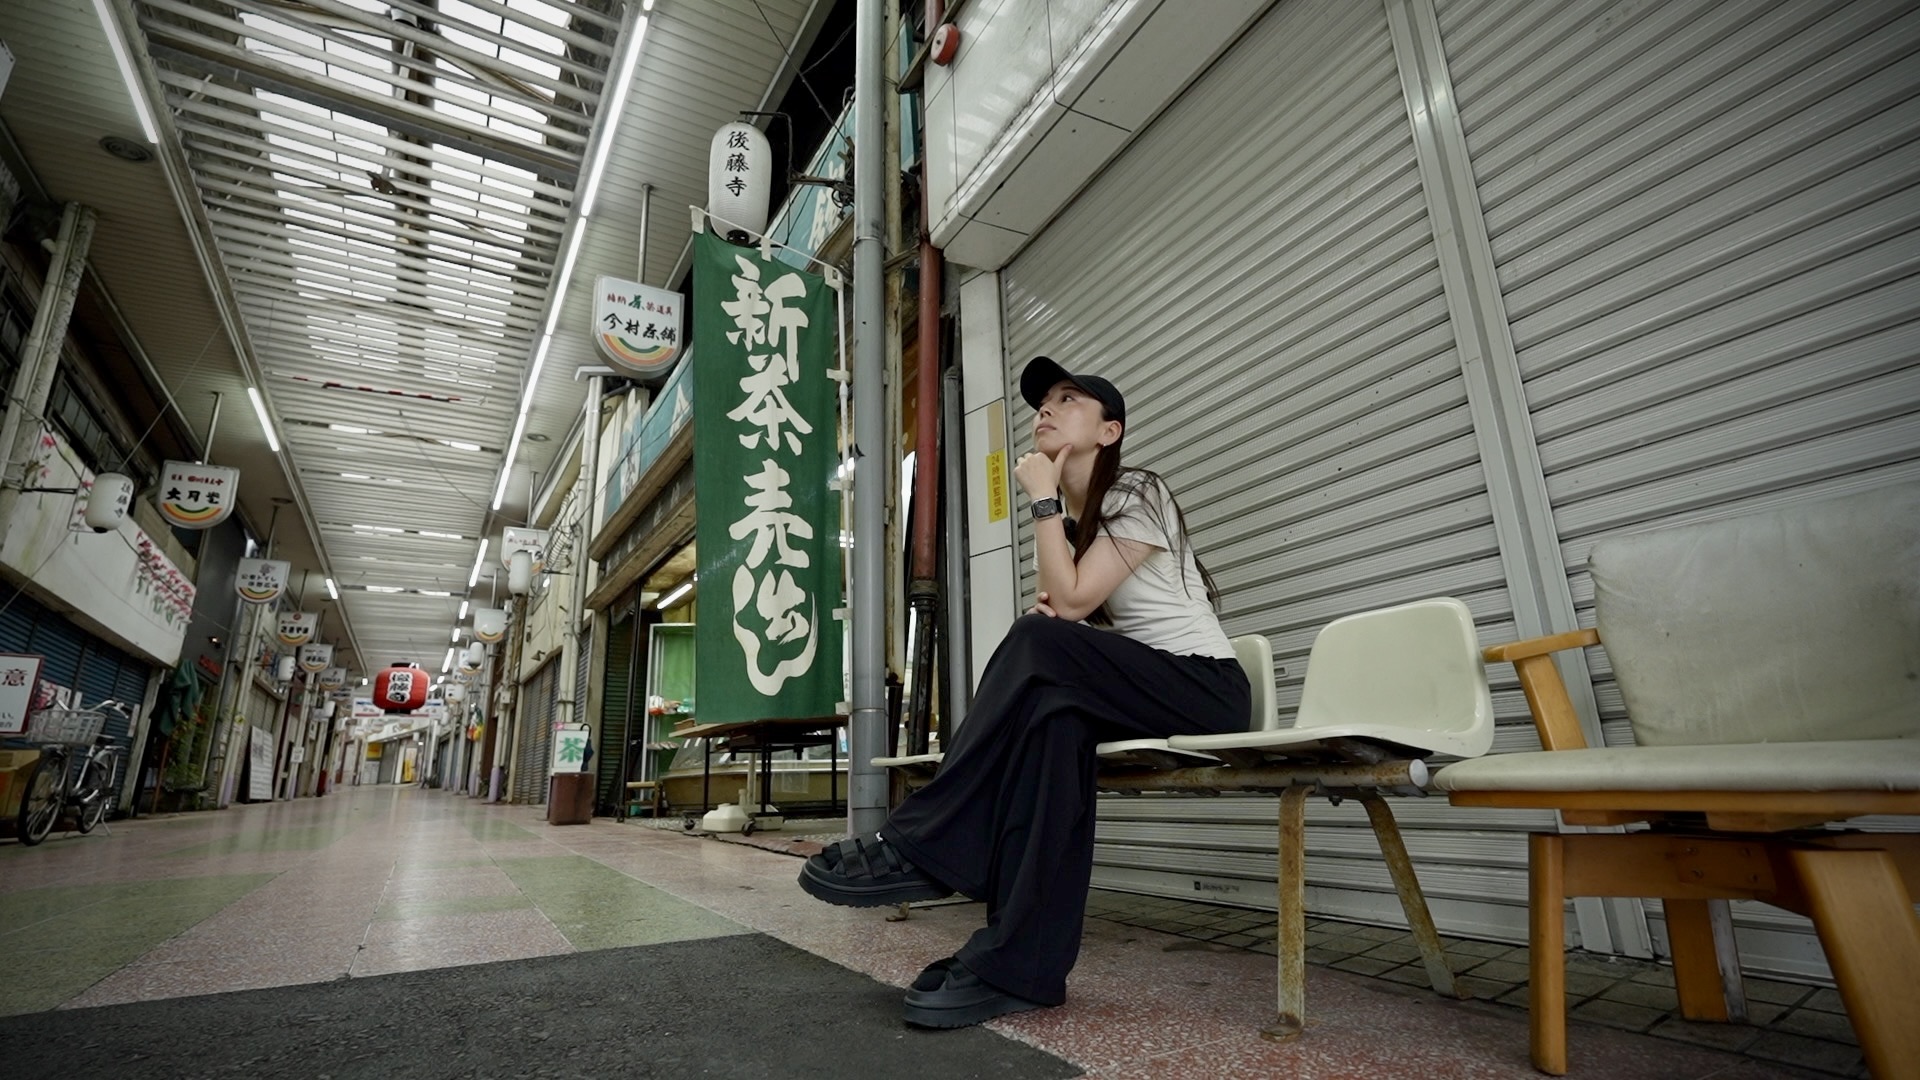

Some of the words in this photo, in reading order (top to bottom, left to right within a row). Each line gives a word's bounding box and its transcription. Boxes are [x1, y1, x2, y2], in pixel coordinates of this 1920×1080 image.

[725, 130, 750, 197] 後藤寺
[603, 312, 677, 346] 今村茶舗
[114, 482, 132, 518] 後藤寺
[165, 487, 220, 505] 大月堂
[0, 667, 28, 685] 意
[557, 737, 585, 763] 茶
